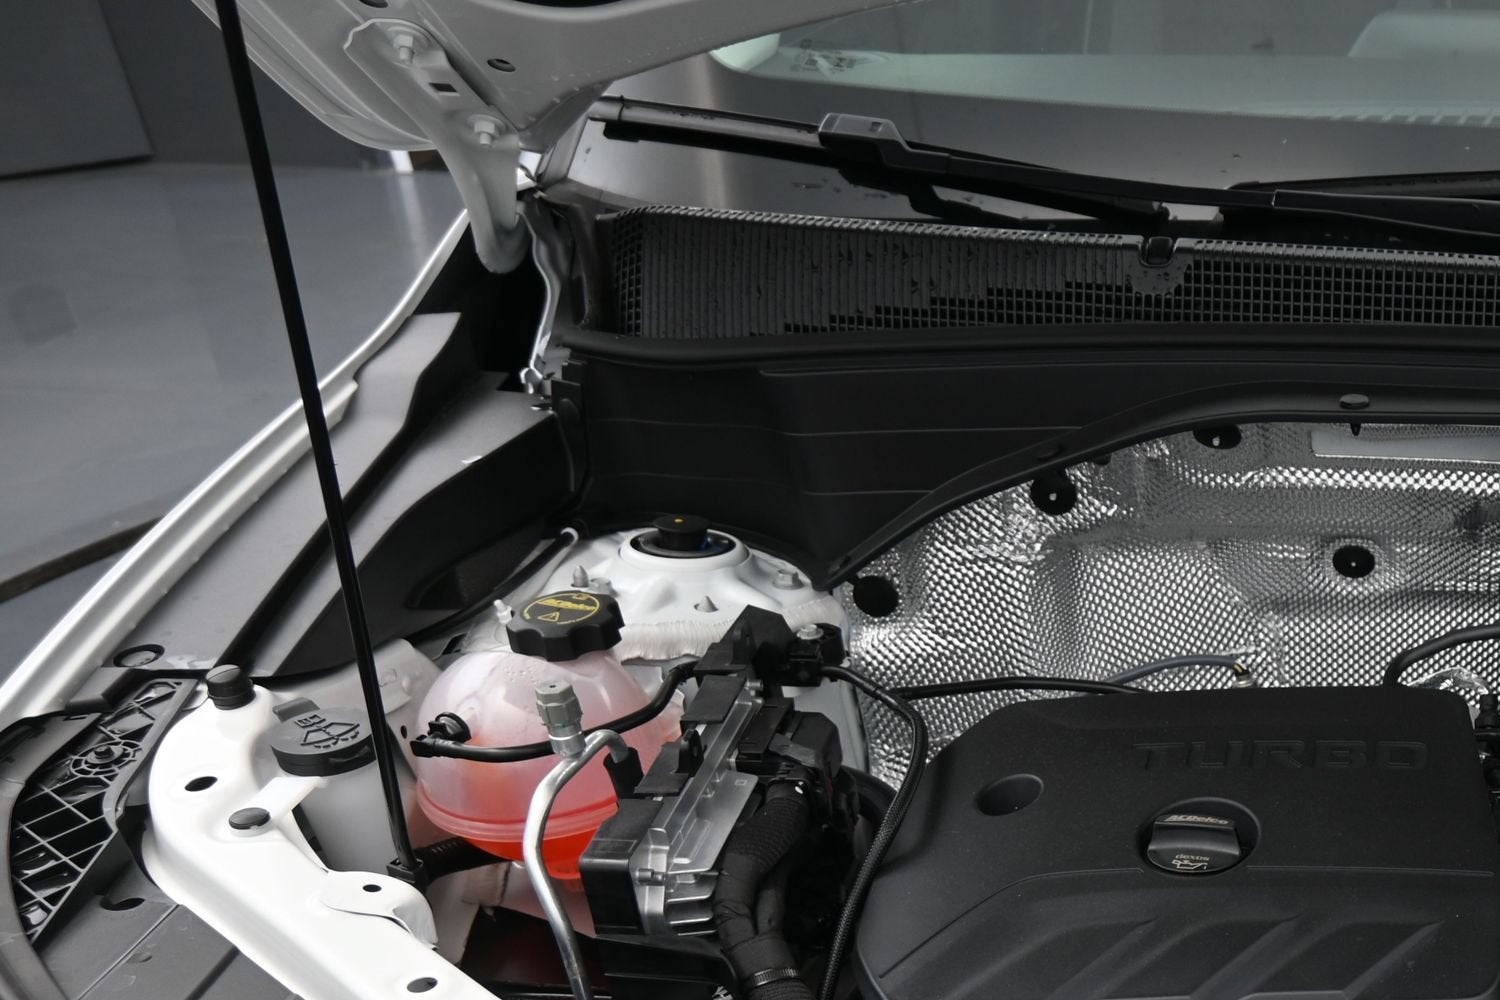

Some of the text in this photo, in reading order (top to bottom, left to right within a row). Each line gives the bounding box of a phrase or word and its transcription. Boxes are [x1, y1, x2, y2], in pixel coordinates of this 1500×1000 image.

[1133, 739, 1427, 771] TURBO
[1164, 814, 1229, 825] ACDelco
[1175, 853, 1210, 861] dexos
